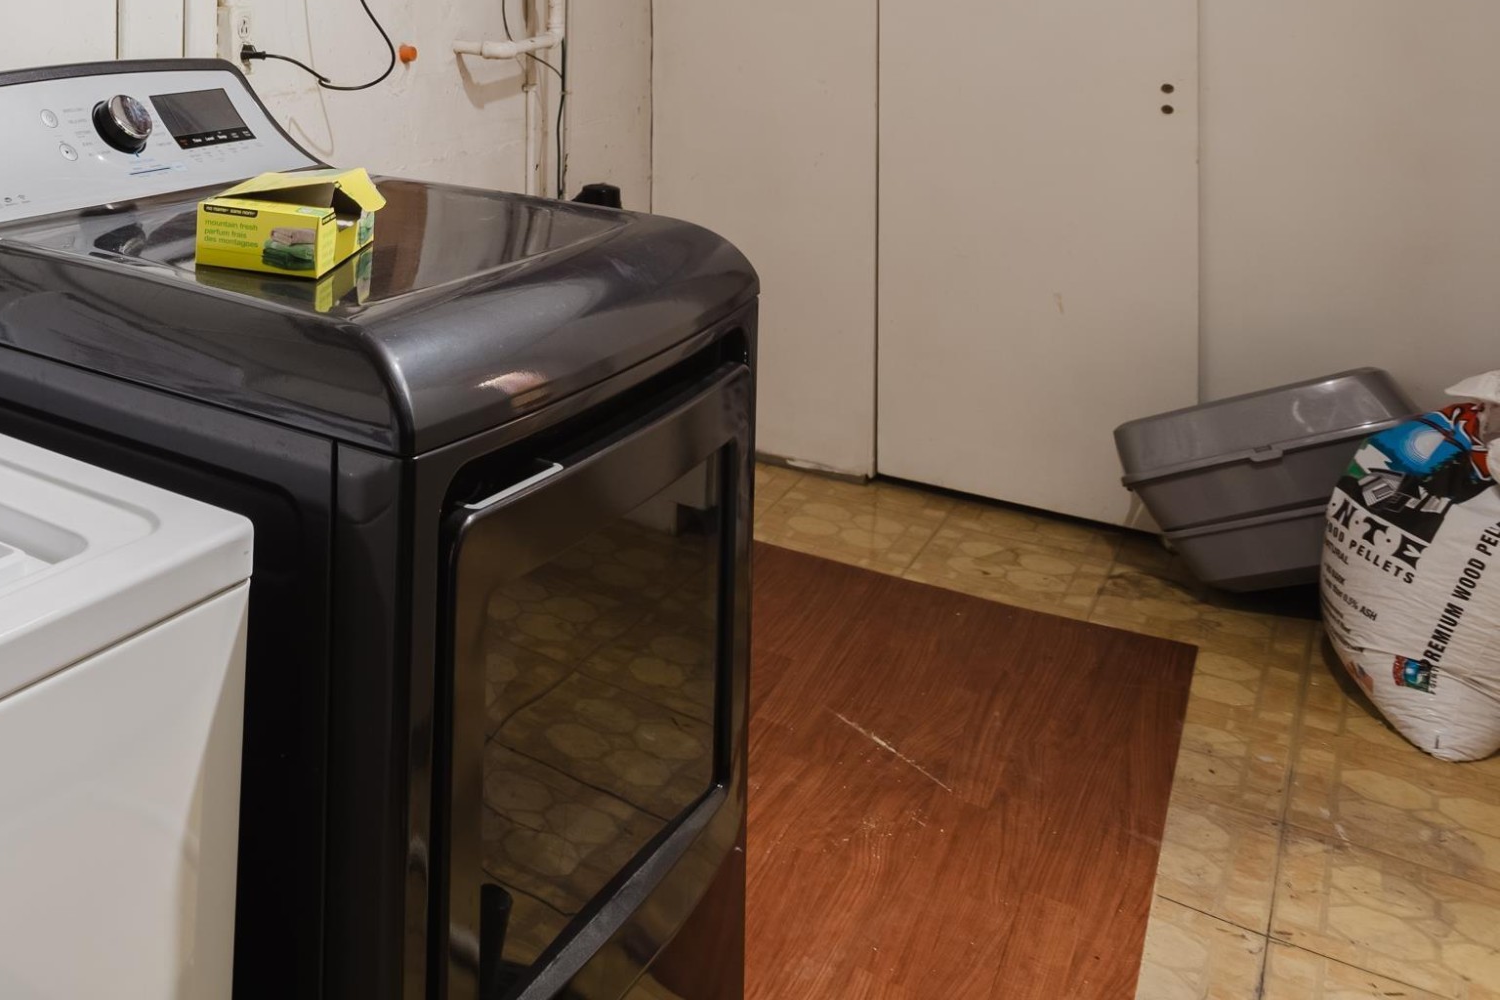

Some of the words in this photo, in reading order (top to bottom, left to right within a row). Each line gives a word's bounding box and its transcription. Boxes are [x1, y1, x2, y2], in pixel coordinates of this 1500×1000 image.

[205, 220, 238, 229] mountain
[240, 223, 258, 231] fresh
[204, 228, 230, 237] parfum
[218, 238, 258, 248] montagnes
[1326, 520, 1344, 543] OOD
[1349, 540, 1415, 584] PELLETS
[1359, 605, 1378, 621] ASH
[1419, 602, 1464, 670] PREMIUM
[1451, 557, 1486, 601] WOOD
